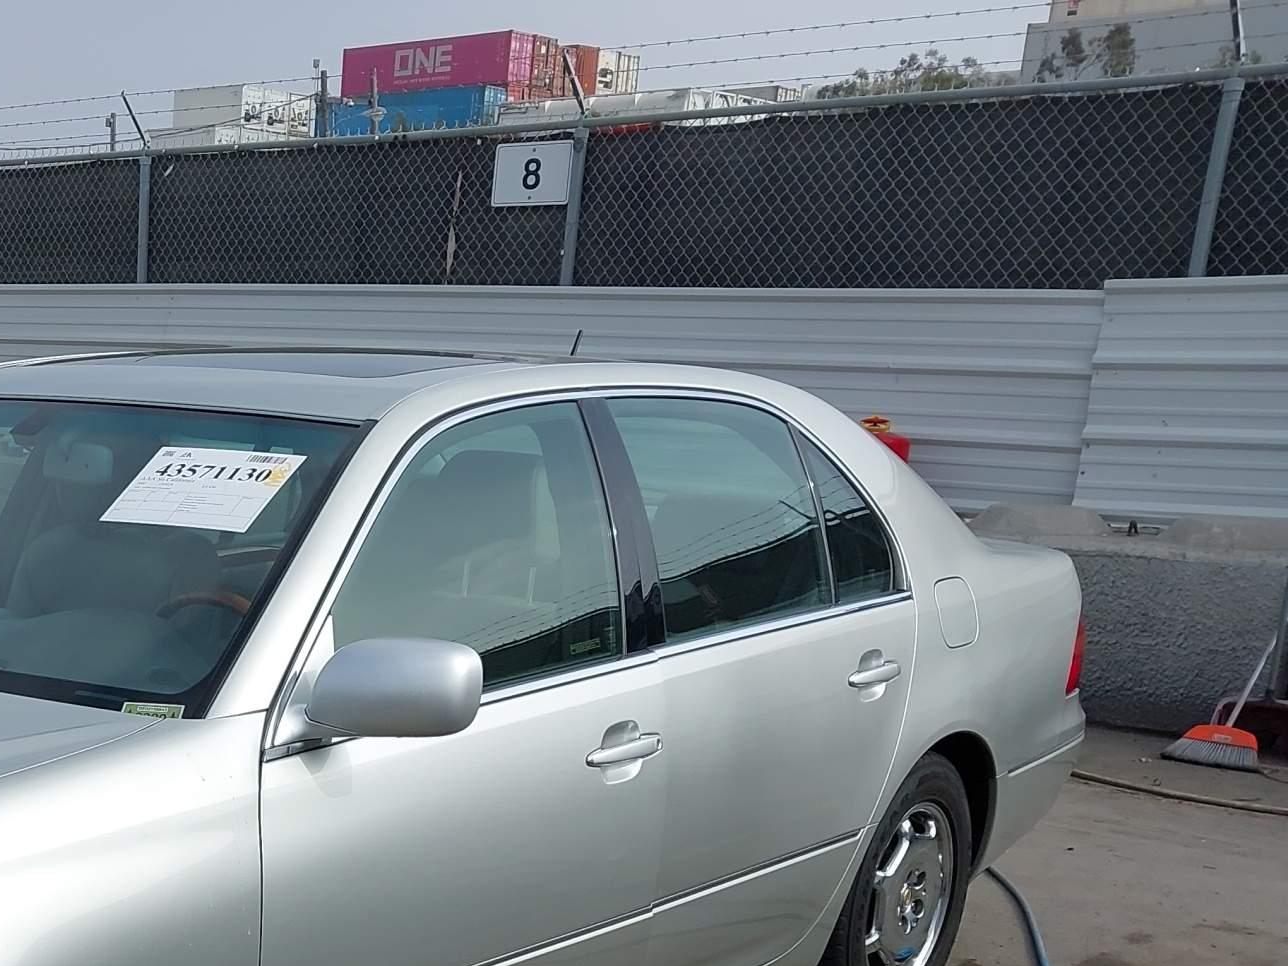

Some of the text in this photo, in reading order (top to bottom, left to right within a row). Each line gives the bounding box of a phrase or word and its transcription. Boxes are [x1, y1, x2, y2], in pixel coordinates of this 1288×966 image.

[394, 44, 453, 77] ONE
[522, 157, 542, 190] 8
[155, 463, 272, 483] 43571130
